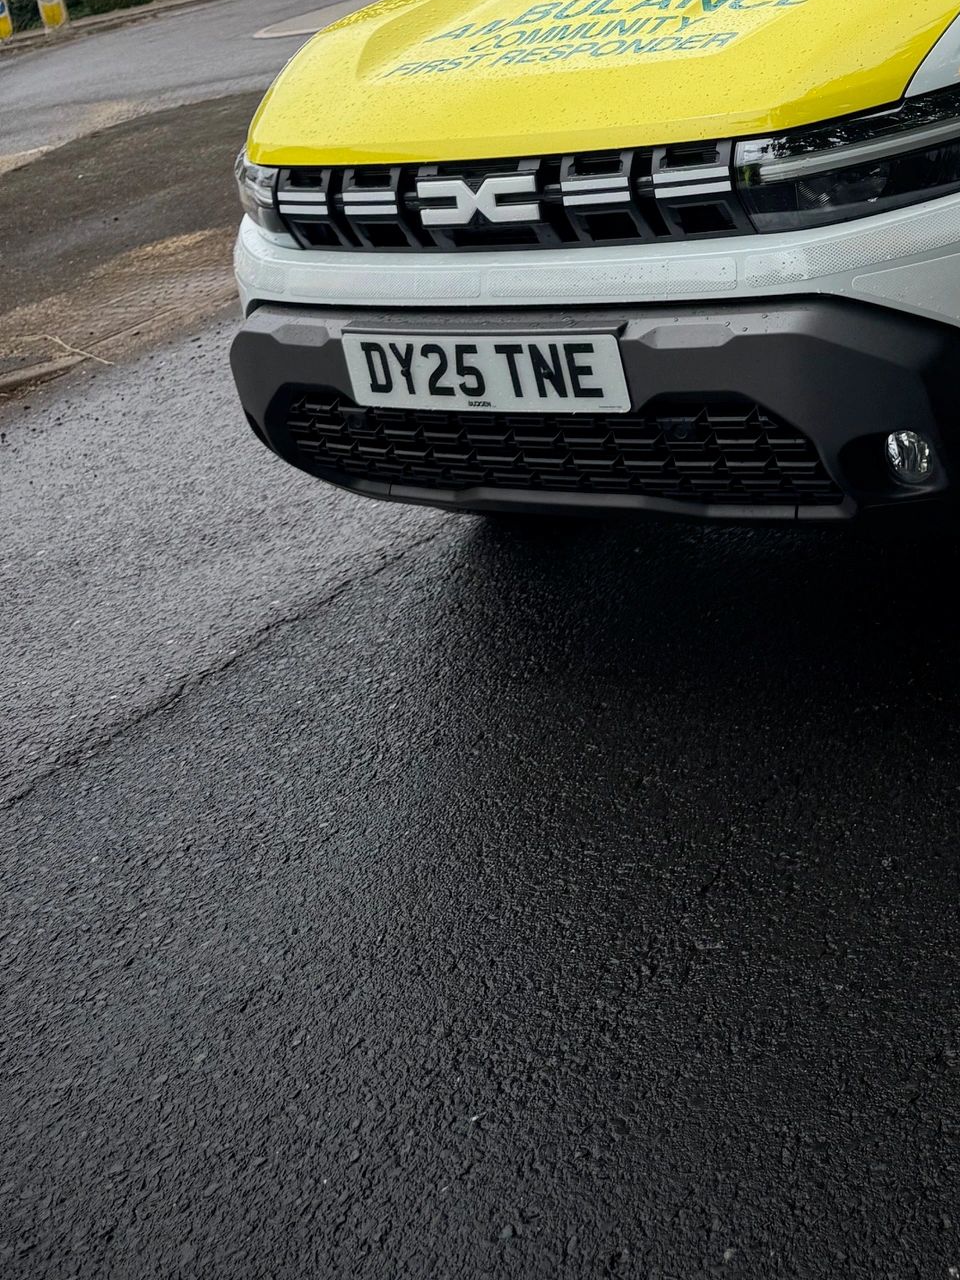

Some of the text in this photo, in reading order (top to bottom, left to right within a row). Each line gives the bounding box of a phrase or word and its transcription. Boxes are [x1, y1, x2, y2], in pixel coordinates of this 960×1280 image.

[383, 32, 739, 78] FIRST RESPONDER
[468, 15, 707, 53] COMMUNITY
[360, 341, 605, 398] DY25 TNE
